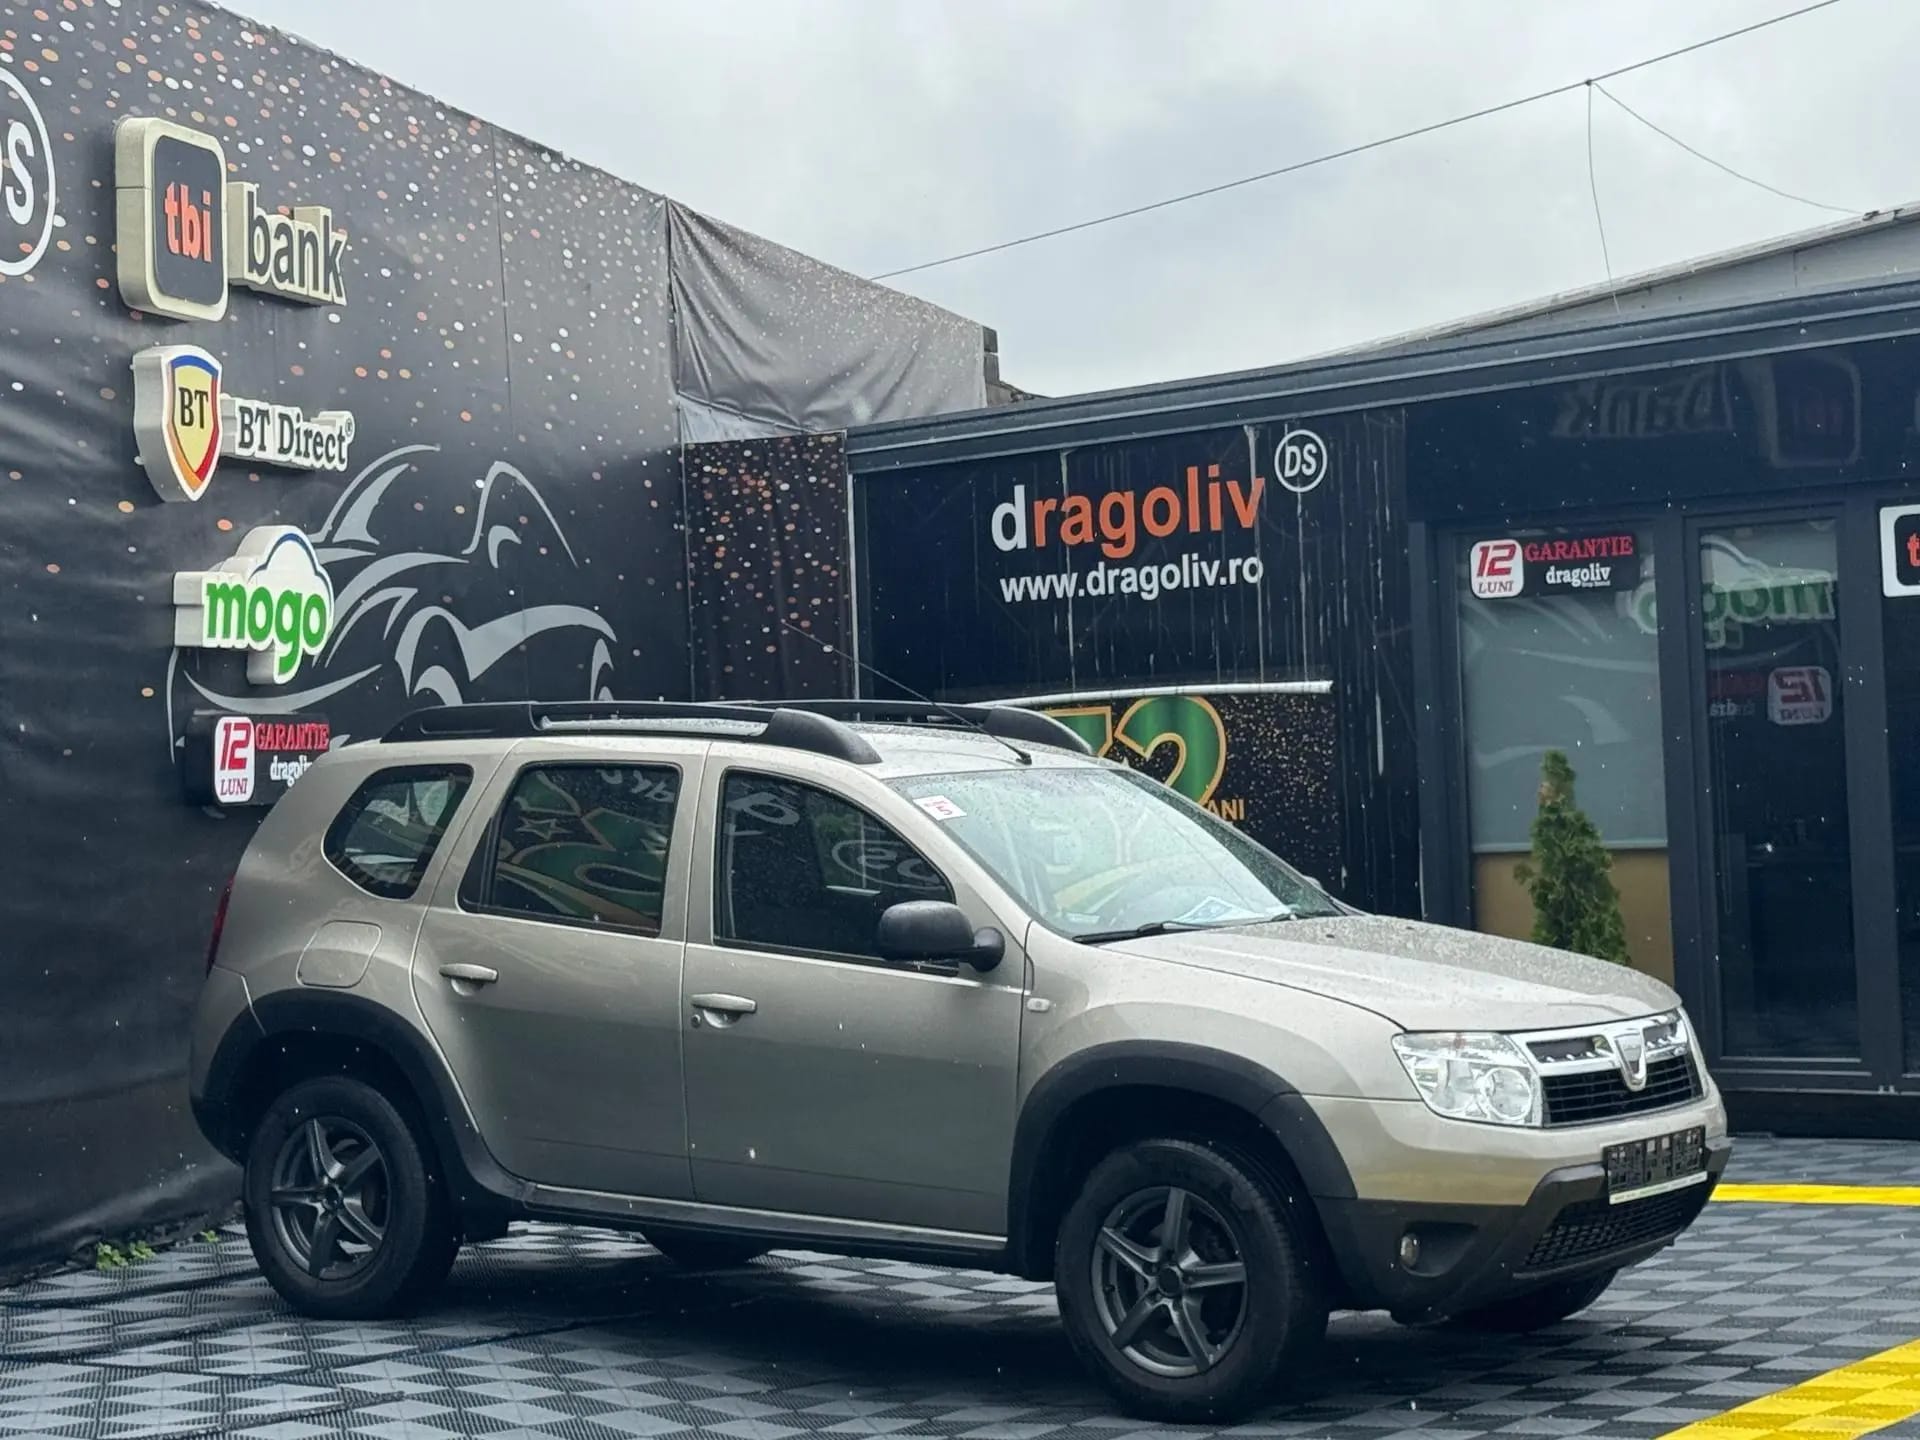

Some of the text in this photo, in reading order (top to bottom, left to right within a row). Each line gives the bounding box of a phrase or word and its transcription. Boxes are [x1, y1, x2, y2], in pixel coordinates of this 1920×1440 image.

[0, 121, 34, 225] S
[164, 181, 347, 301] tbi bank
[178, 387, 209, 429] BT
[238, 405, 270, 452] BT
[1283, 443, 1318, 478] DS
[991, 464, 1265, 559] dragoliv
[1000, 553, 1264, 602] www.dragoliv.ro
[1476, 535, 1633, 578] 12 GARANTIE
[1545, 562, 1611, 587] dragoliv
[1478, 580, 1514, 595] LUNI
[206, 582, 327, 676] mogo
[220, 722, 330, 771] 12 GARANTIE
[220, 777, 249, 796] LUNI
